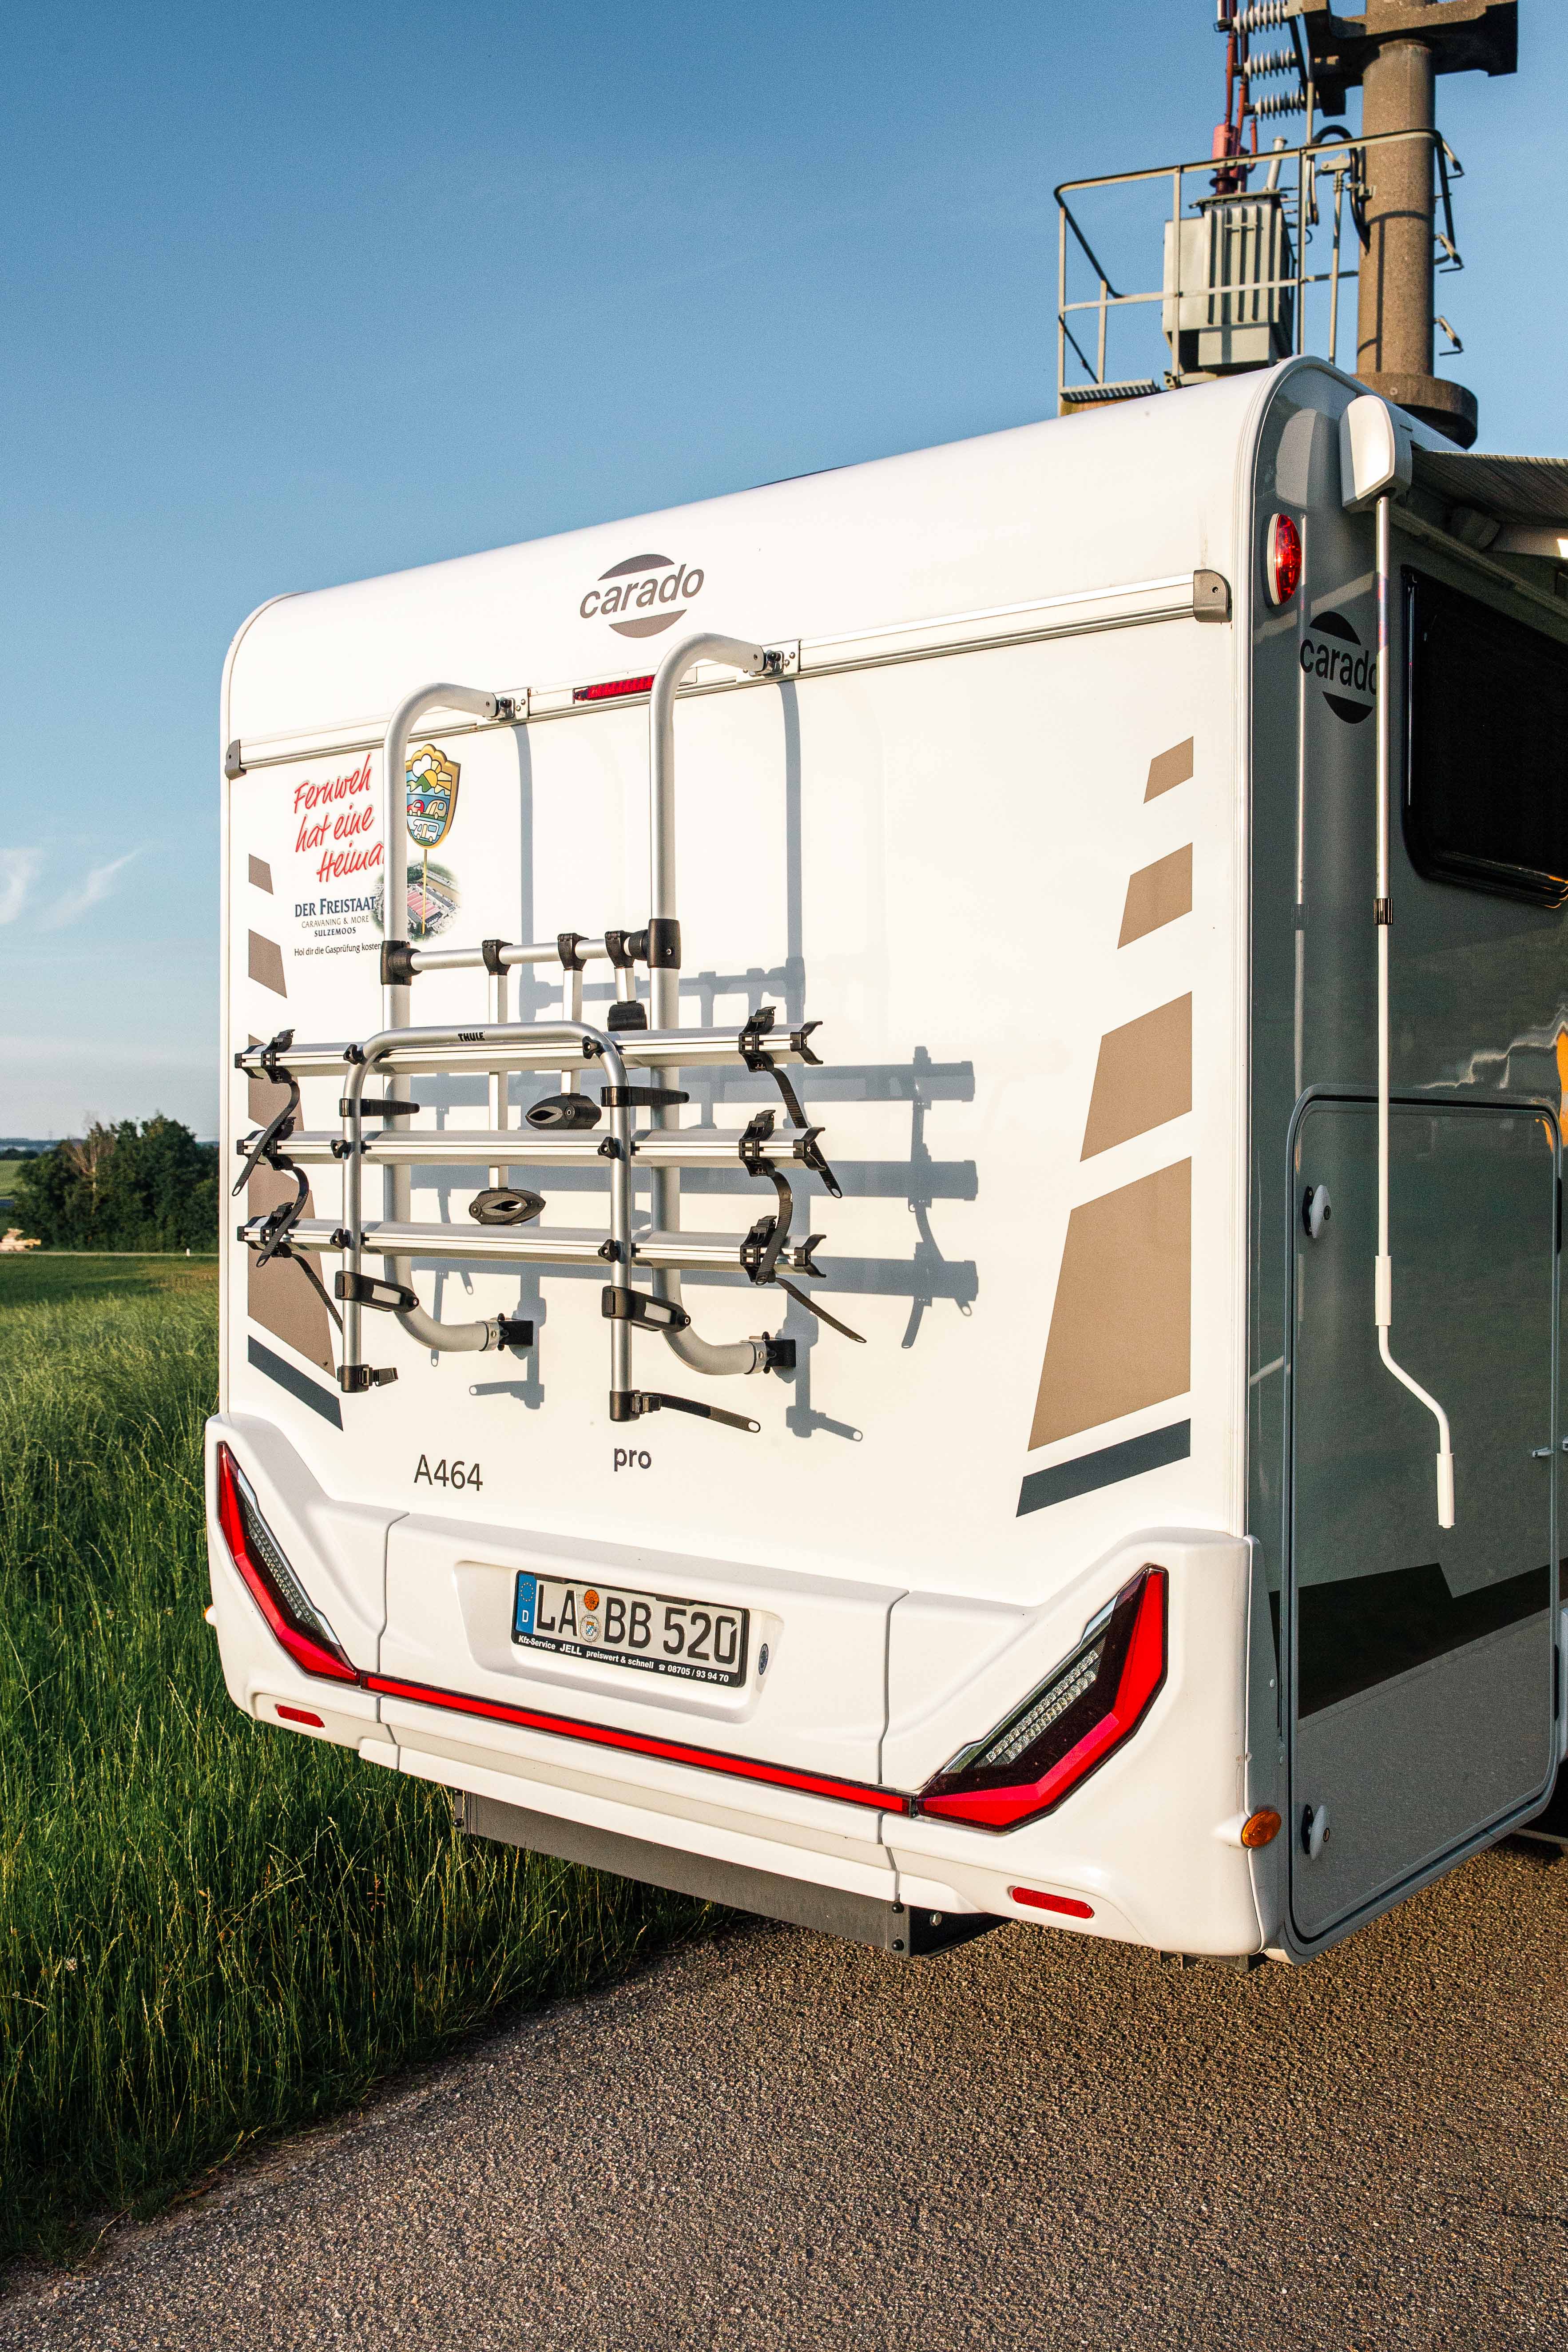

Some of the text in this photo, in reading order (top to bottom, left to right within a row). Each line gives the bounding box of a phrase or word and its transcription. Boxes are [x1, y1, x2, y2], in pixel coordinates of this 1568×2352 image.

[580, 564, 704, 619] carado
[294, 753, 371, 814] Fernweh
[295, 805, 374, 852] hat eine
[316, 842, 384, 882] Heima
[295, 896, 376, 918] DER FREISTAAT
[302, 918, 341, 928] CARAVANING
[314, 927, 356, 937] SULZEMOOS
[294, 948, 305, 956] Hol
[314, 946, 324, 955] die
[325, 944, 361, 955] Gasprüfung
[457, 1031, 485, 1042] THULE
[414, 1454, 483, 1491] A464
[614, 1448, 651, 1472] pro
[521, 1609, 529, 1623] D
[536, 1584, 578, 1637] LA
[603, 1596, 651, 1649] BB
[663, 1606, 737, 1665] 520
[518, 1635, 556, 1650] Kfz-Service
[560, 1643, 582, 1656] JELL
[586, 1650, 619, 1663] preiswert
[620, 1656, 626, 1664] &
[627, 1657, 654, 1669] schnell
[667, 1664, 691, 1676] 08705
[696, 1669, 706, 1678] 93
[707, 1672, 717, 1681] 94
[719, 1673, 729, 1682] 70
